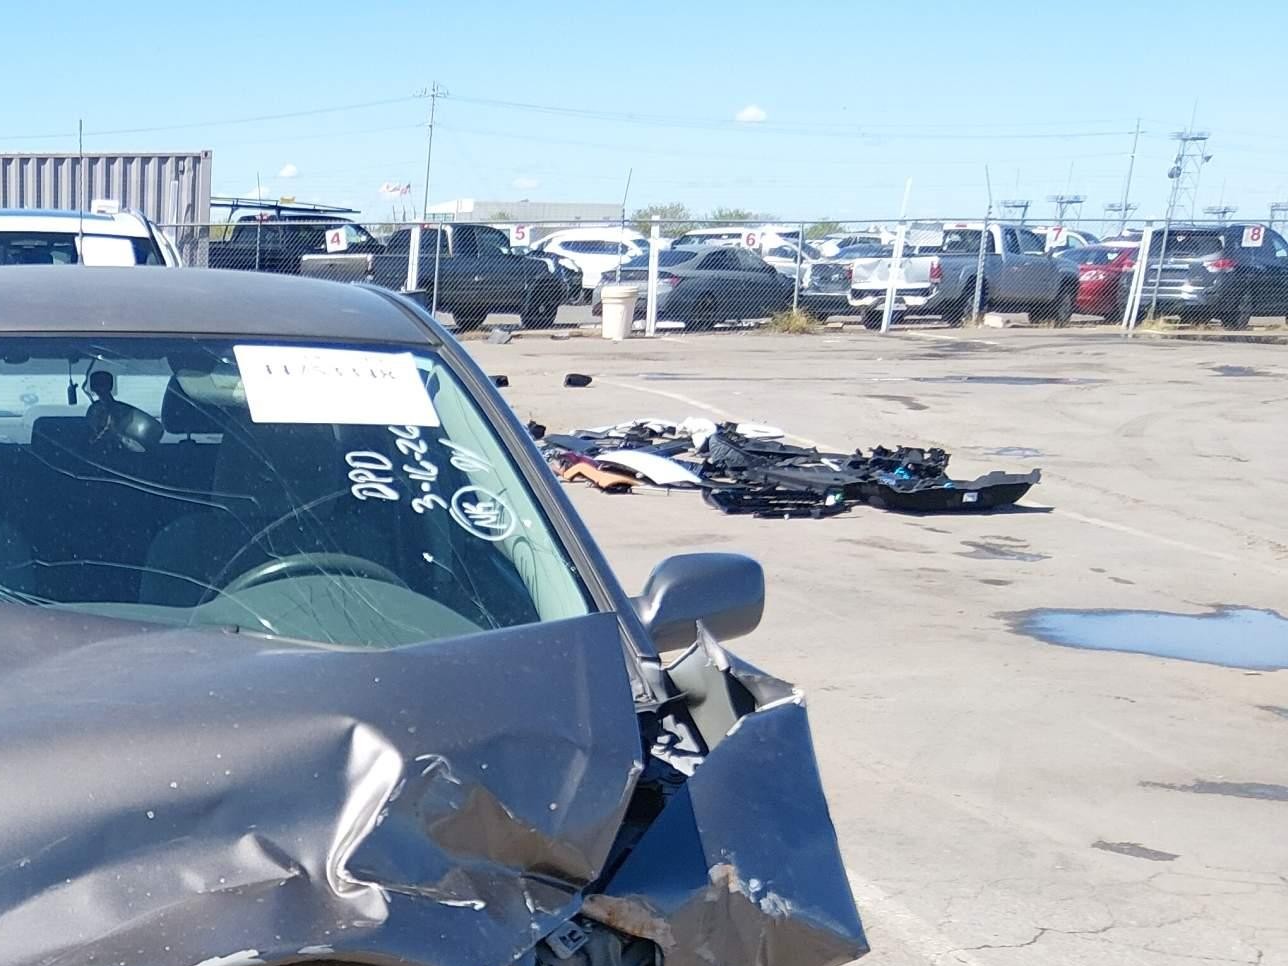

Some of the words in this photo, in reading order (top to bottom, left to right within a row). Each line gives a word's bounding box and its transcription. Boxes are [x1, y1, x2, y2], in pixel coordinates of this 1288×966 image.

[330, 232, 341, 246] 4
[515, 225, 525, 240] 5
[746, 232, 756, 247] 6
[1052, 226, 1063, 241] 7
[1251, 227, 1261, 241] 8
[345, 450, 400, 501] DPD
